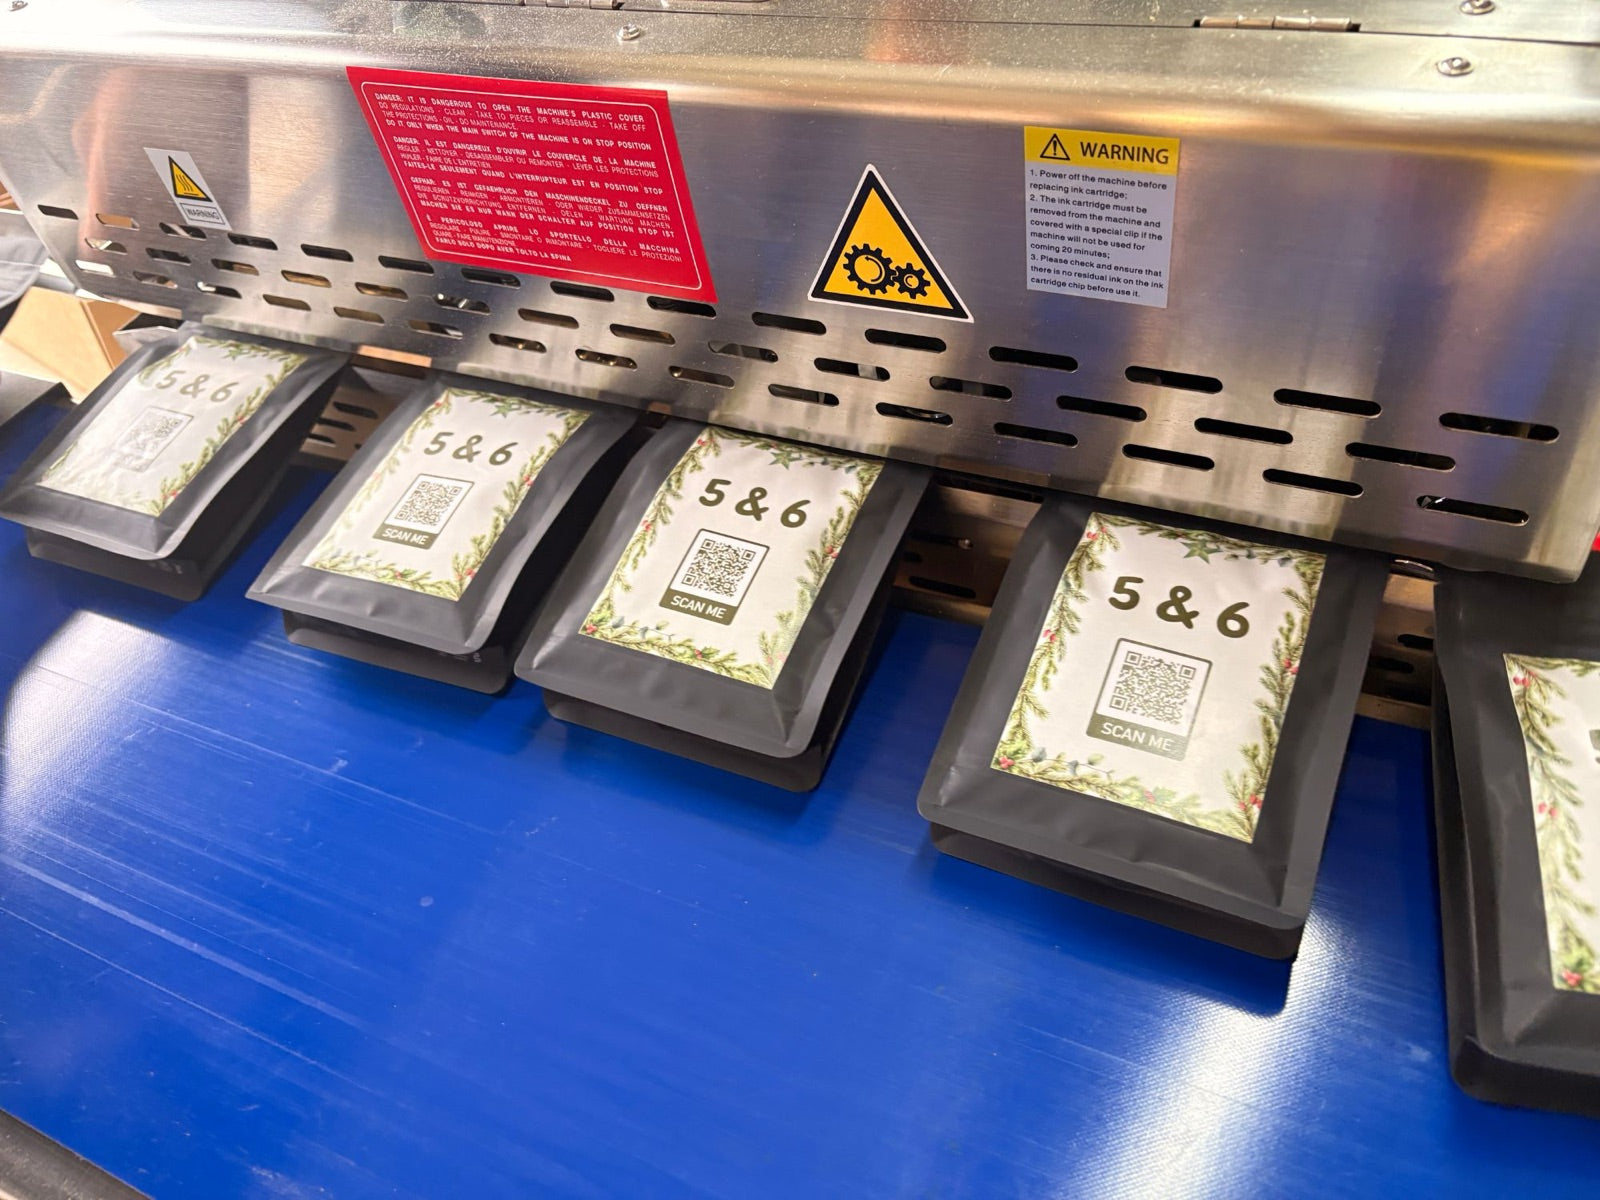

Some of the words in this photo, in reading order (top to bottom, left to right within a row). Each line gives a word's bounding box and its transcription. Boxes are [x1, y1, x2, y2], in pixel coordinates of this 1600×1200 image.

[430, 98, 472, 107] DANGEROUS
[536, 106, 576, 116] MACHINE'S
[581, 110, 612, 119] PLASTIC
[618, 113, 644, 122] COVER
[480, 128, 506, 136] SWITCH
[537, 133, 568, 142] MACHINE
[617, 141, 651, 150] POSITION
[546, 151, 586, 161] COUVERCLE
[623, 159, 656, 168] MACHINE
[1080, 141, 1169, 164] WARNING
[481, 168, 505, 177] QUAND
[508, 171, 567, 184] L'INTERRUPTEUR
[604, 182, 639, 192] POSITION
[643, 187, 663, 195] STOP
[1039, 169, 1065, 178] Power
[1098, 176, 1135, 186] machine
[1137, 180, 1166, 189] before
[1029, 182, 1068, 193] replacing
[1085, 188, 1126, 199] cartridge;
[1072, 199, 1110, 210] cartridge
[1030, 207, 1066, 216] removed
[1105, 216, 1141, 225] machine
[1030, 219, 1063, 228] covered
[1092, 226, 1121, 236] special
[1124, 230, 1138, 238] clip
[1030, 230, 1064, 240] machine
[1030, 243, 1059, 253] coming
[1074, 248, 1109, 258] minutes;
[1040, 254, 1067, 264] Please
[1070, 259, 1094, 267] check
[1114, 266, 1142, 274] ensure
[1030, 276, 1066, 287] cartridge
[1068, 282, 1085, 290] chip
[1087, 284, 1113, 293] before
[1074, 271, 1106, 280] residual
[156, 370, 186, 389] 5
[179, 374, 210, 398] &
[210, 382, 239, 402] 6
[424, 432, 454, 456] 5
[452, 435, 483, 462] &
[489, 442, 518, 466] 6
[698, 478, 732, 506] 5
[735, 487, 770, 521] &
[780, 500, 811, 528] 6
[382, 528, 410, 542] SCAN
[410, 532, 429, 545] ME
[671, 596, 705, 613] SCAN
[705, 606, 726, 618] ME
[1108, 576, 1144, 610] 5
[1156, 586, 1200, 629] &
[1217, 602, 1250, 638] 6
[1101, 722, 1146, 743] SCAN
[1148, 735, 1174, 752] ME
